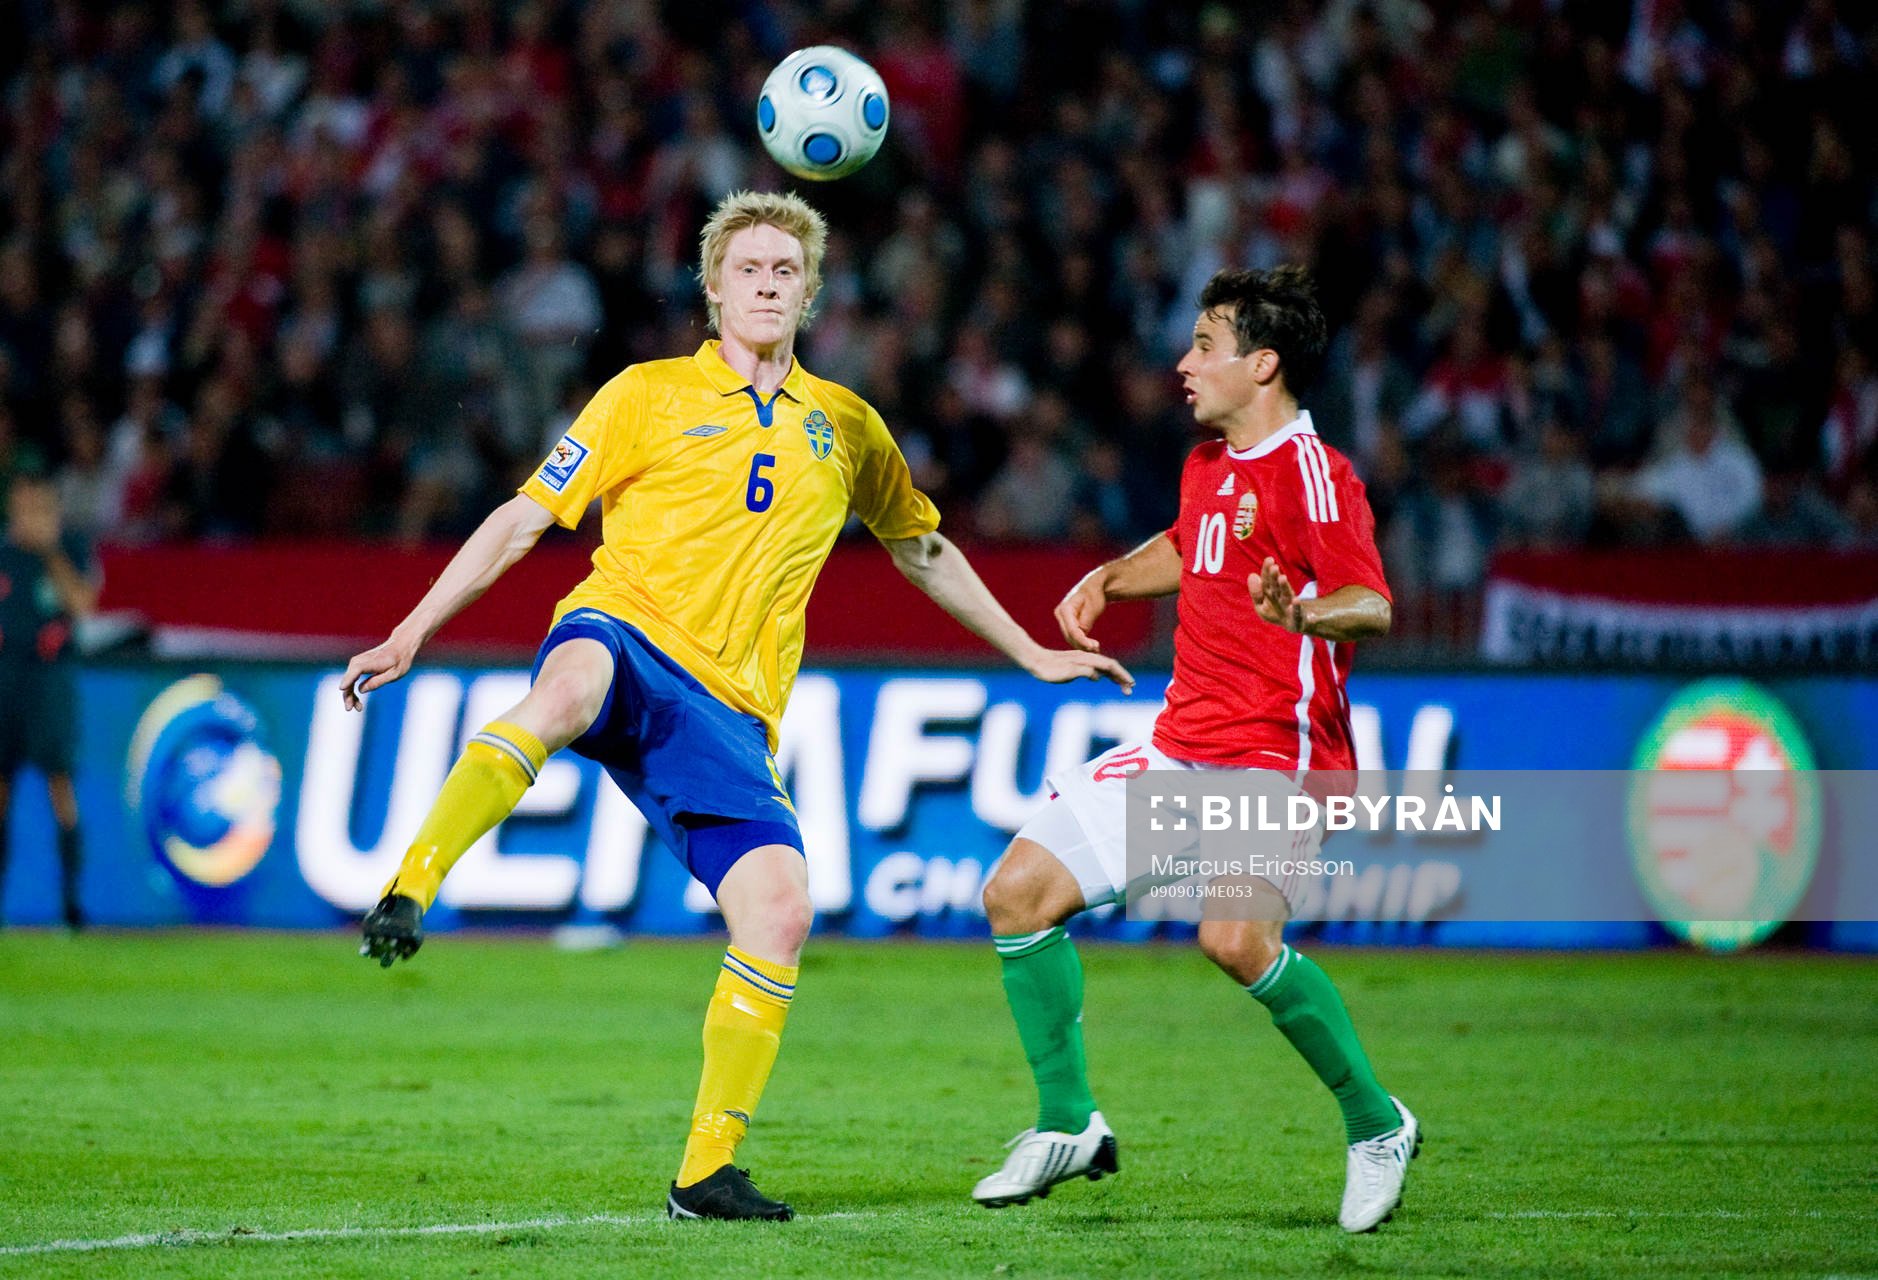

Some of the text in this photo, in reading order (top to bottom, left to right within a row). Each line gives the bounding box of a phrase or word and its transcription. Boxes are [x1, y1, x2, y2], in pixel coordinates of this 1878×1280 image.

[746, 453, 775, 513] 6
[1192, 512, 1227, 574] 10
[296, 673, 852, 911] UEA
